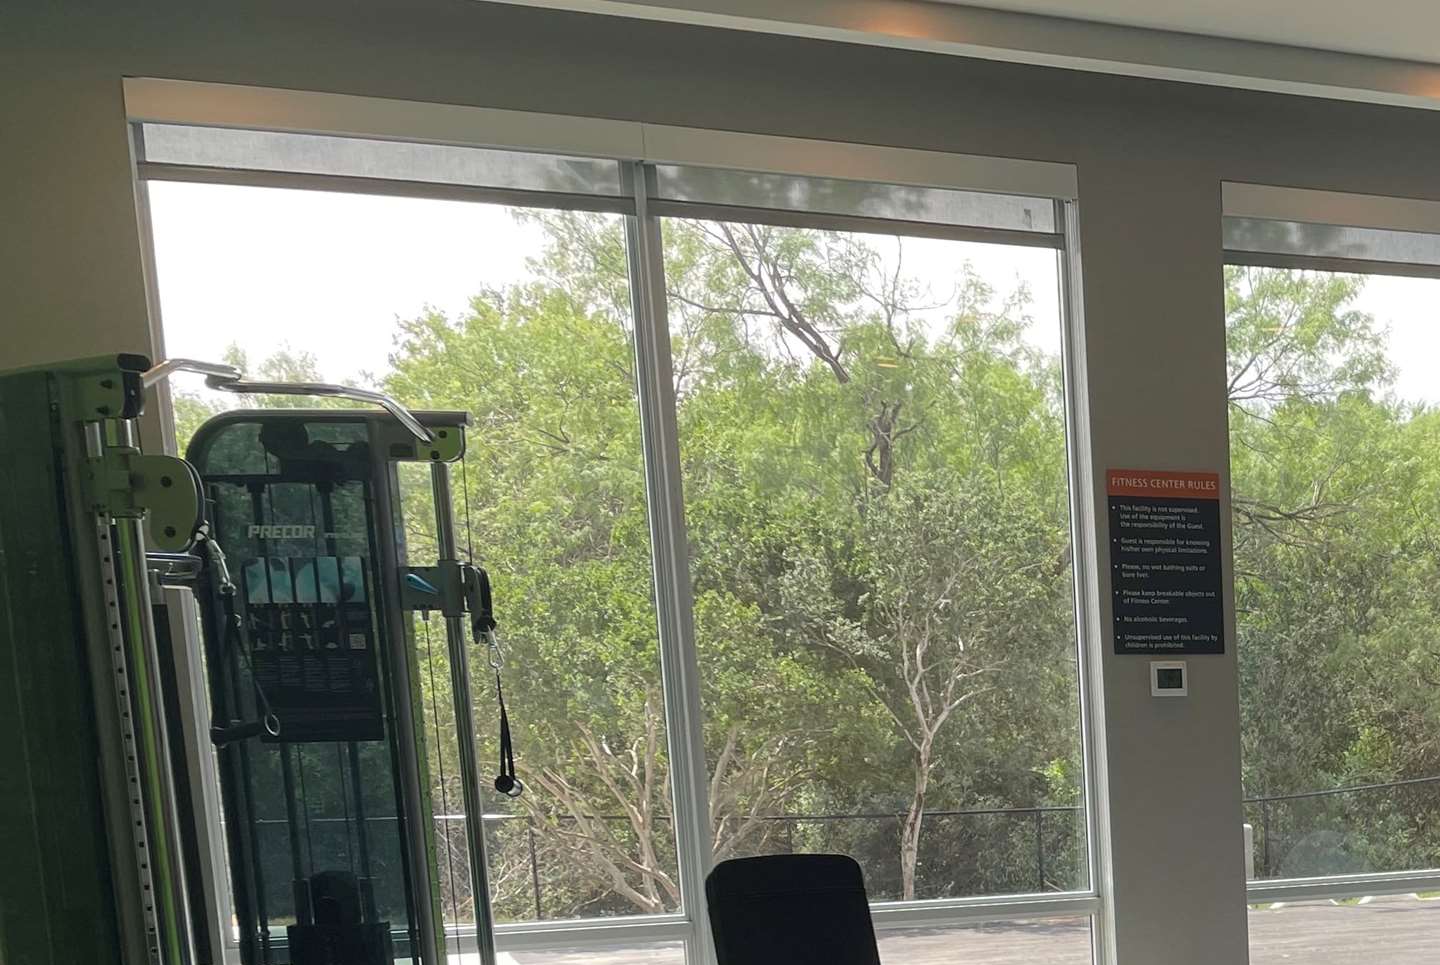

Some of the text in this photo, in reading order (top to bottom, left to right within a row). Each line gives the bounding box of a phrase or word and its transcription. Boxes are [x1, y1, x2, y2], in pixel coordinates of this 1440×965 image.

[1111, 477, 1217, 490] FITNESS CENTER RULES
[247, 525, 316, 539] PRECOR
